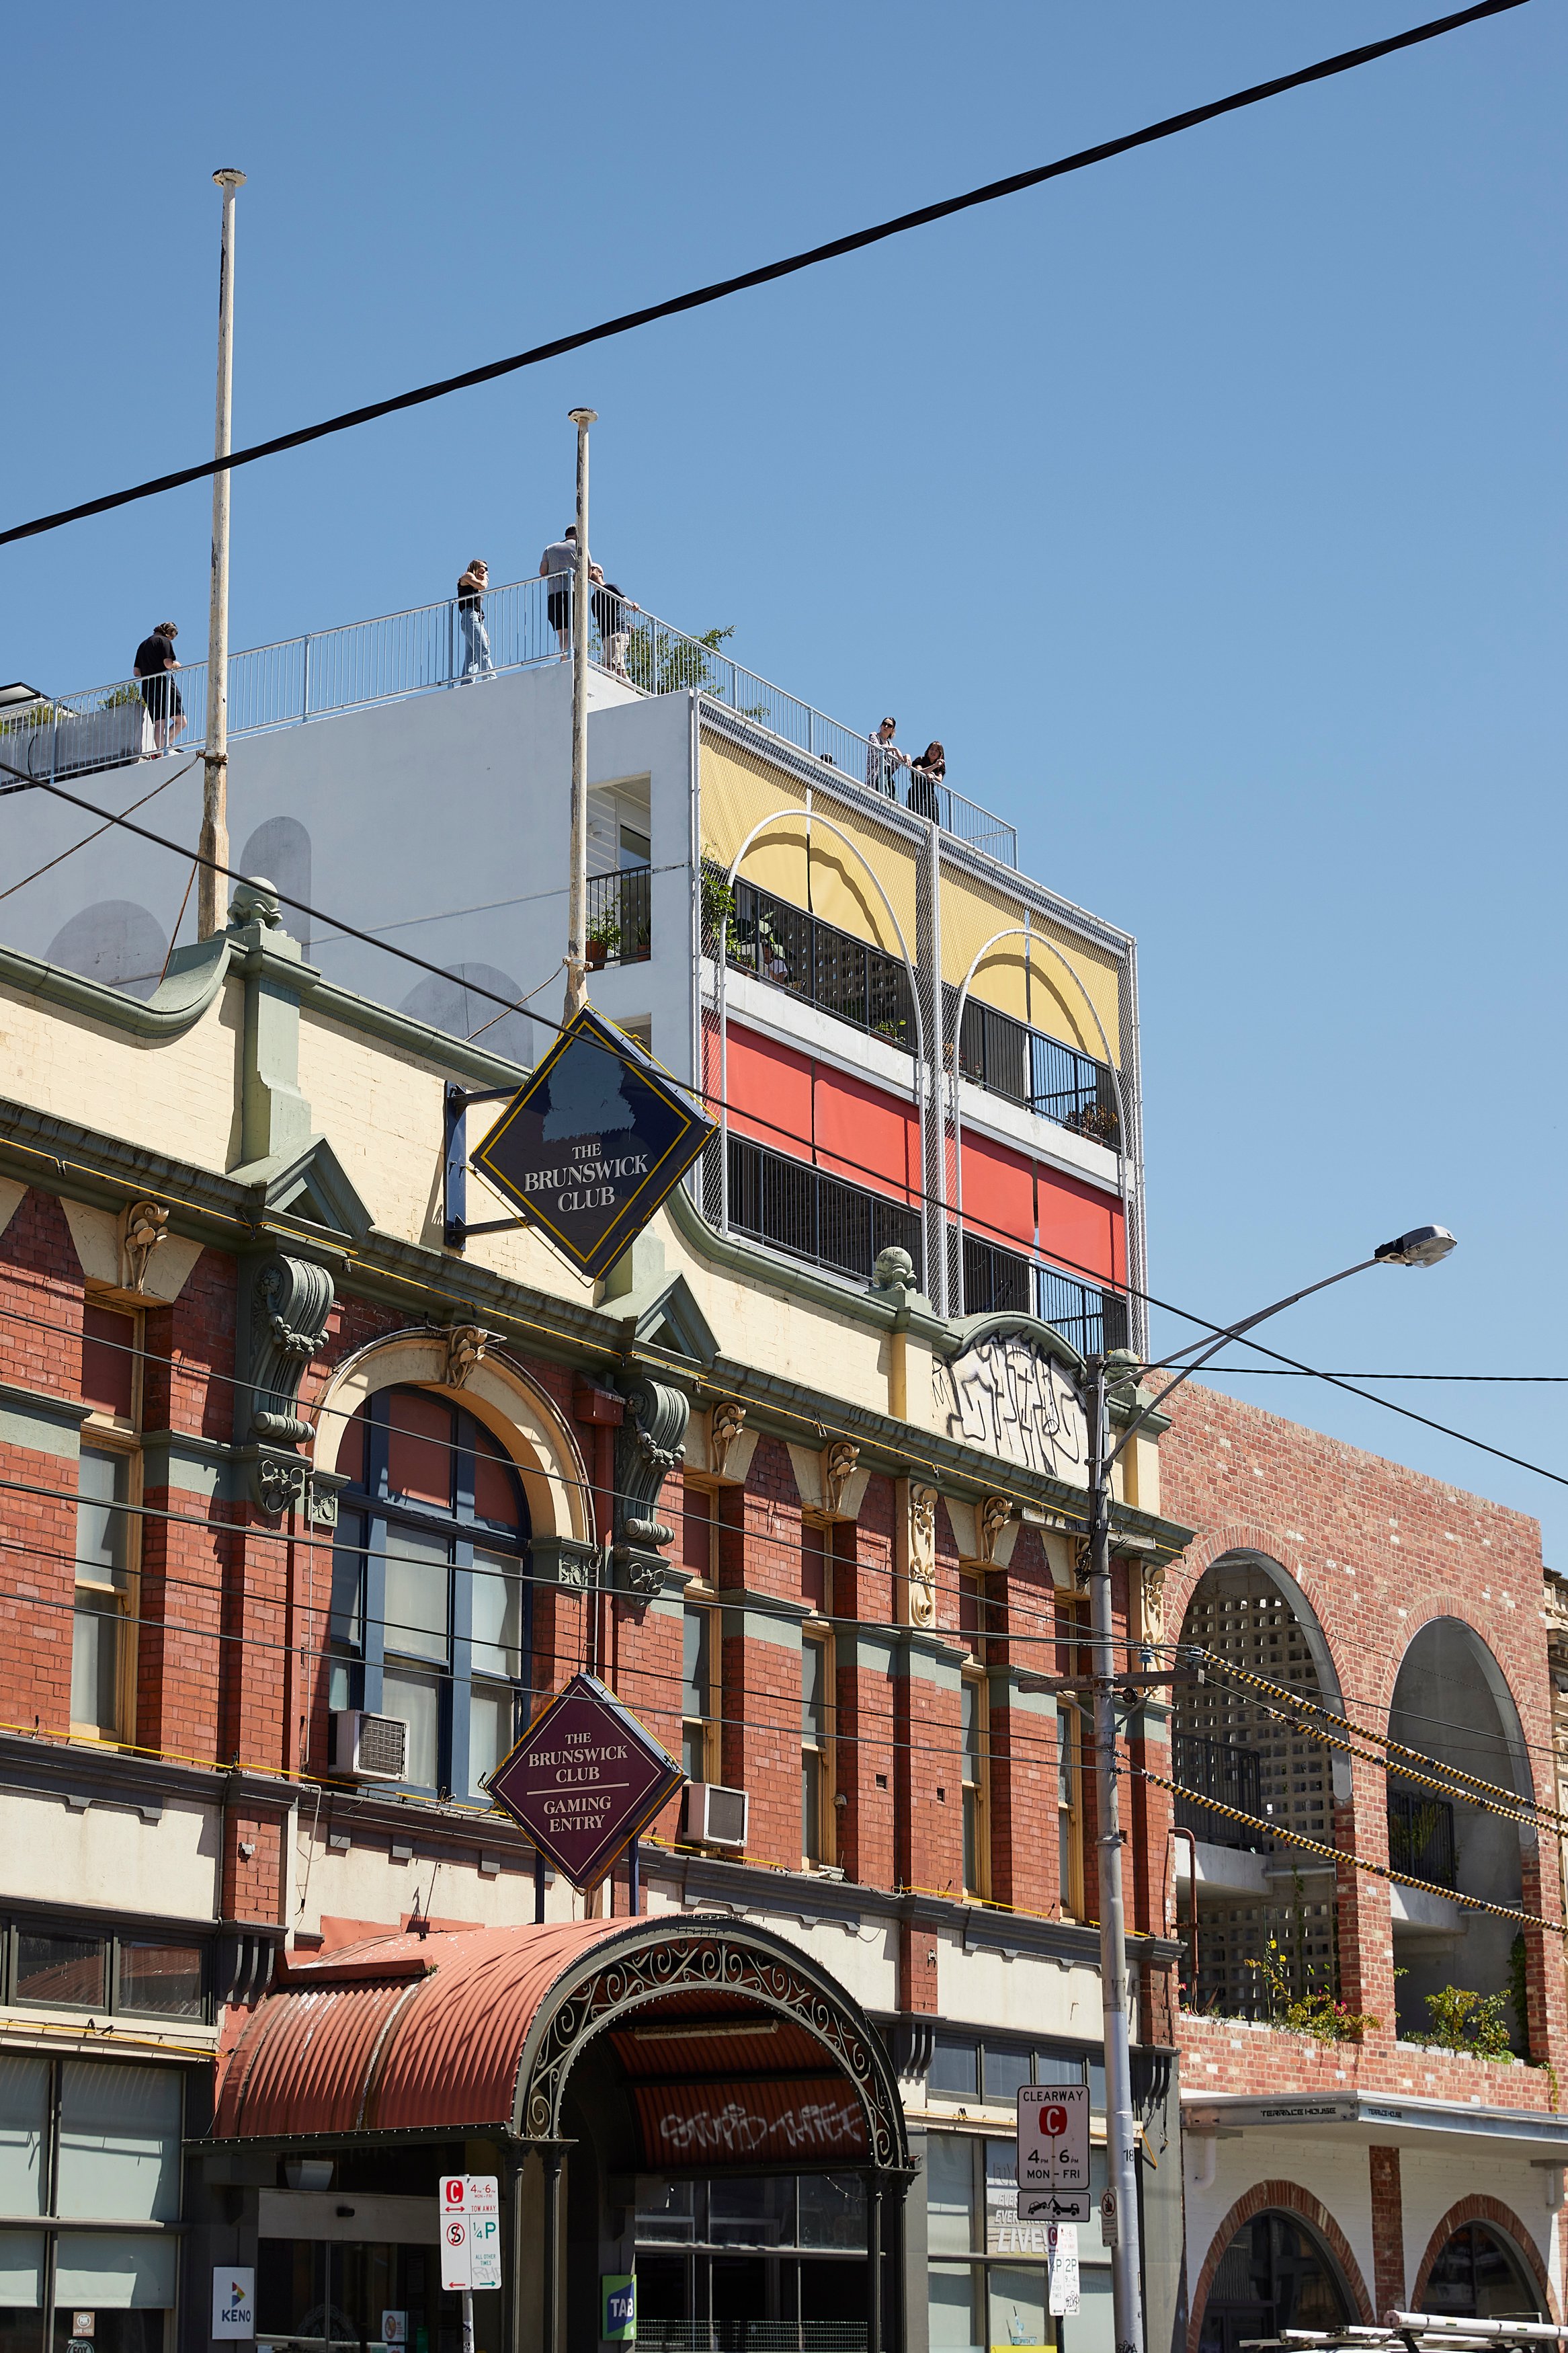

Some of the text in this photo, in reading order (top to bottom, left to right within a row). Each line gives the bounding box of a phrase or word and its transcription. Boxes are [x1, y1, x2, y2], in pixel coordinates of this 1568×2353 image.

[572, 1143, 602, 1159] THE
[524, 1153, 649, 1193] BRUNSWICK
[557, 1186, 616, 1213] CLUB
[565, 1732, 591, 1745] THE
[528, 1745, 628, 1767] BRUNSWICK
[555, 1767, 600, 1784] CLUB
[543, 1796, 612, 1814] GAMING
[549, 1814, 606, 1833] ENTRY
[1023, 2091, 1083, 2102] CLEARWAY
[1260, 2107, 1337, 2117] TERRACE HOUSE
[1368, 2108, 1402, 2118] TERRACE HOUSE
[1027, 2169, 1050, 2179] MON
[1063, 2169, 1080, 2179] FRI
[222, 2309, 251, 2322] KENO
[610, 2298, 634, 2317] TAB
